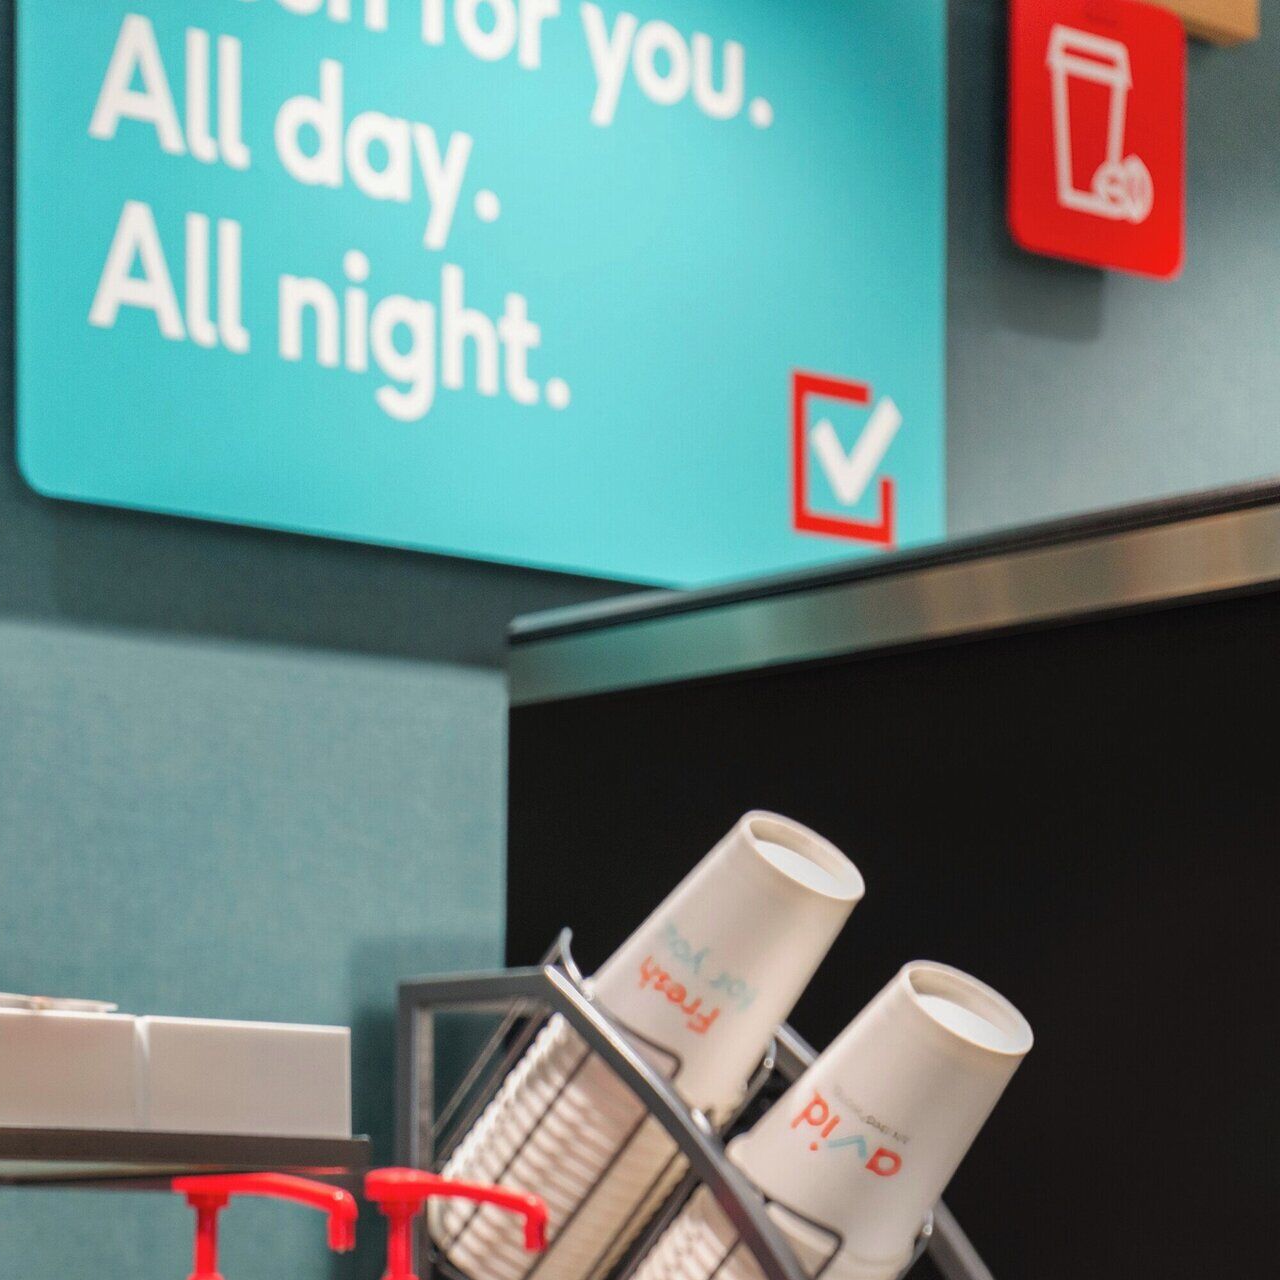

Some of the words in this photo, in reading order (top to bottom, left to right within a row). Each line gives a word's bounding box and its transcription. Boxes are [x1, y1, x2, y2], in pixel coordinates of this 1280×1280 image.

[87, 12, 252, 172] All
[274, 57, 501, 250] day.
[579, 1, 775, 130] you.
[87, 199, 251, 354] All
[277, 249, 572, 422] night.
[638, 955, 721, 1035] Fresh
